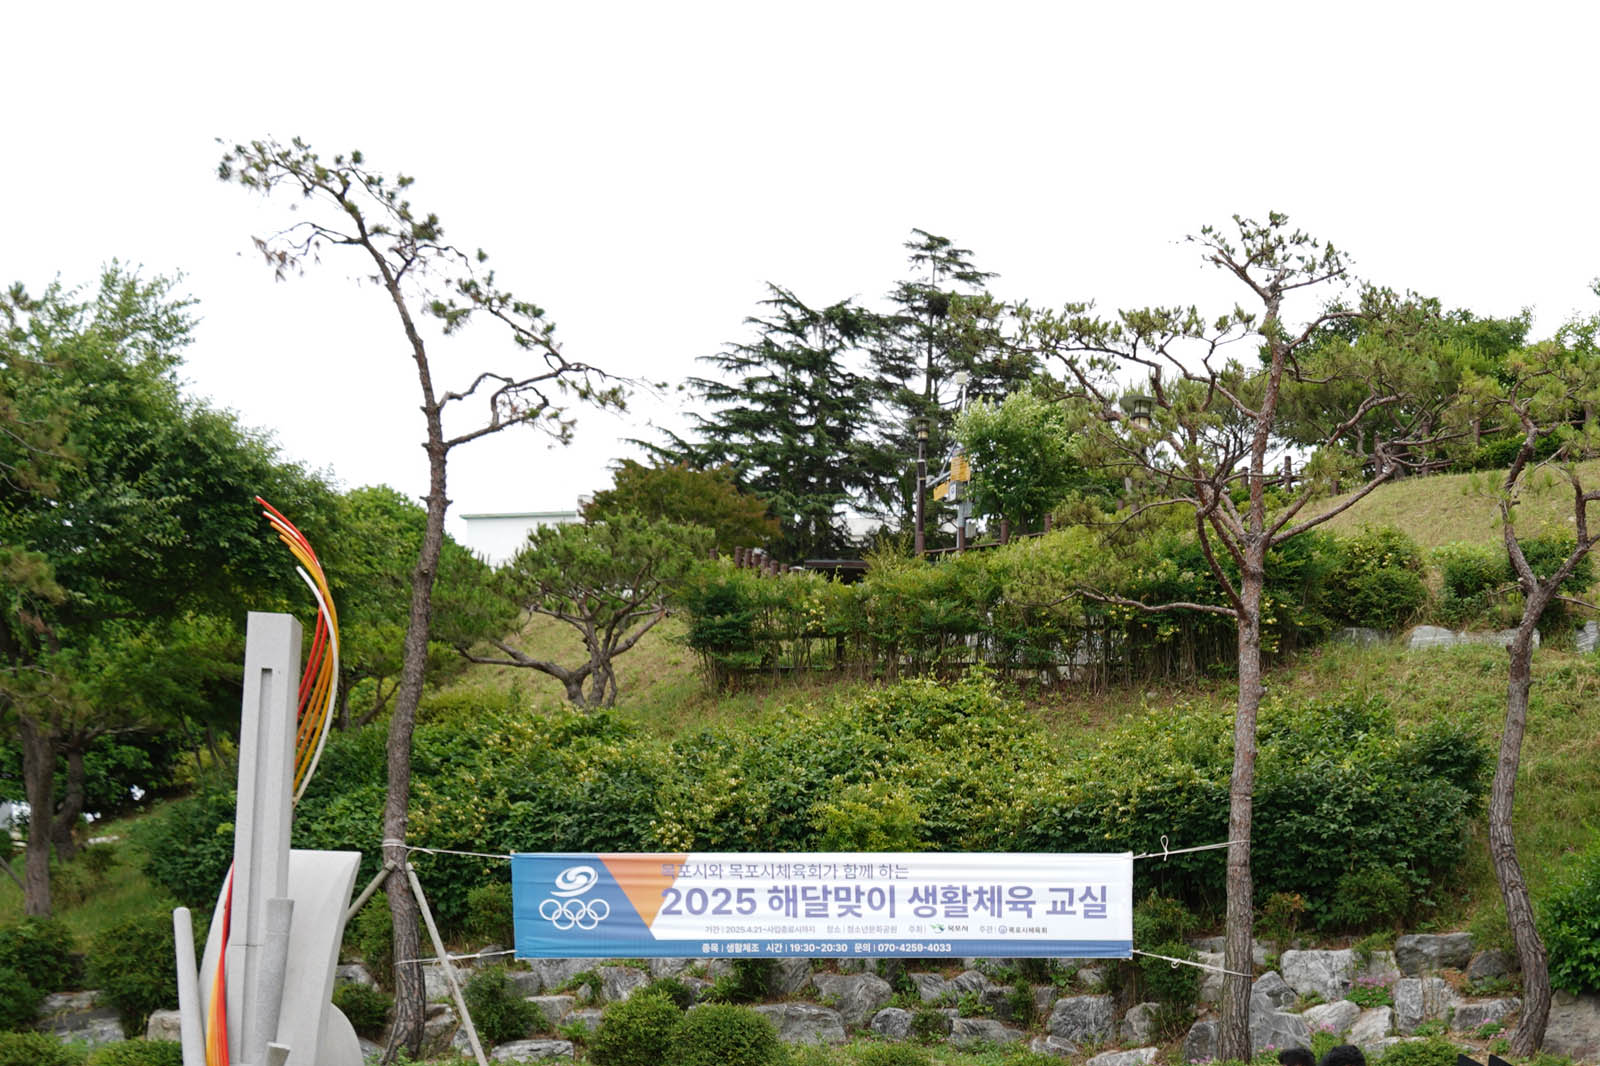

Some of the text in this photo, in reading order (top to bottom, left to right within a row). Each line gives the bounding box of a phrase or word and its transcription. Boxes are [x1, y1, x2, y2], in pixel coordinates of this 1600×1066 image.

[660, 863, 910, 880] 목포시와 목포시체육회가 함께 하는
[660, 884, 1108, 919] 2025 해달맞이 생활체육 교실
[765, 943, 783, 953] 시간
[789, 943, 848, 953] 19:30~20:30
[877, 943, 952, 953] 070-4259-4033
